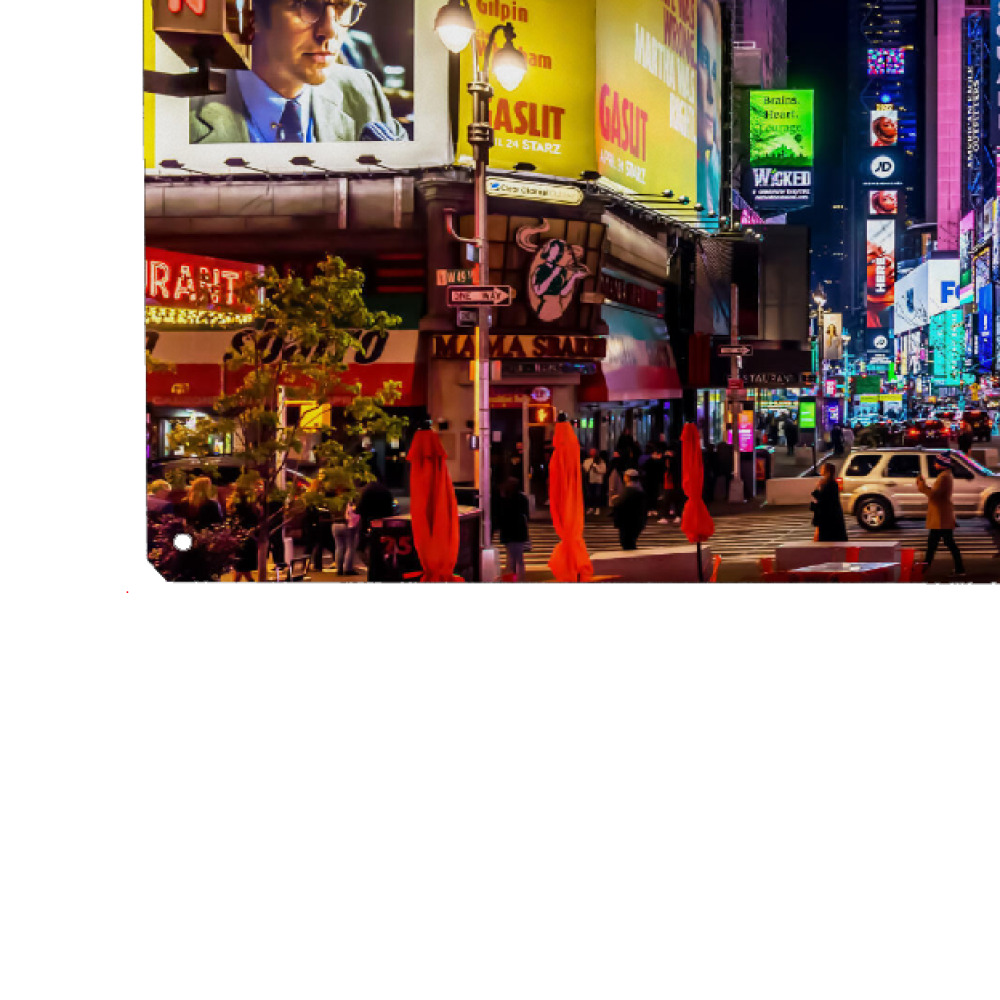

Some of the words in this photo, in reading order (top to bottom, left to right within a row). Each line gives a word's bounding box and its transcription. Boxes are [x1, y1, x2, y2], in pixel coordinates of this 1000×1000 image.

[489, 98, 565, 140] ASLIT
[600, 82, 648, 163] GASLIT
[522, 139, 562, 155] STARZ
[145, 259, 240, 305] RANT
[434, 335, 527, 358] MAMA
